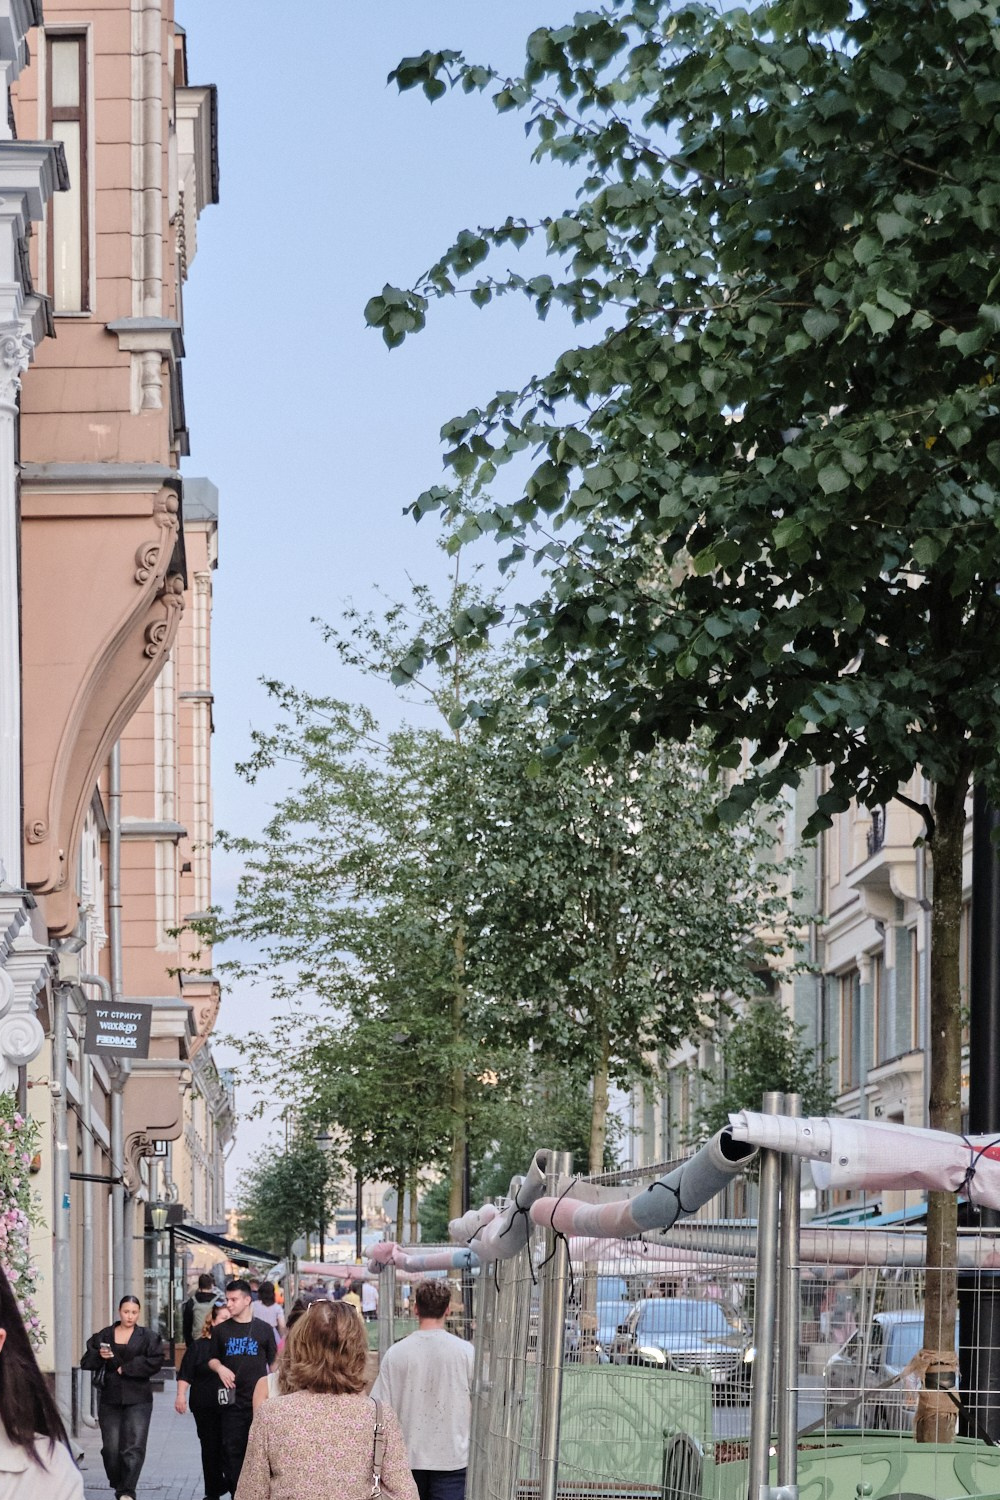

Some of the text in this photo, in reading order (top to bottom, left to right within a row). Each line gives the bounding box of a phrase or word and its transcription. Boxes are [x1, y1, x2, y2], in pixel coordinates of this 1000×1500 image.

[110, 1011, 142, 1020] СТРИГУТ
[99, 1021, 137, 1034] wax&go
[96, 1034, 137, 1046] FEEDBACK
